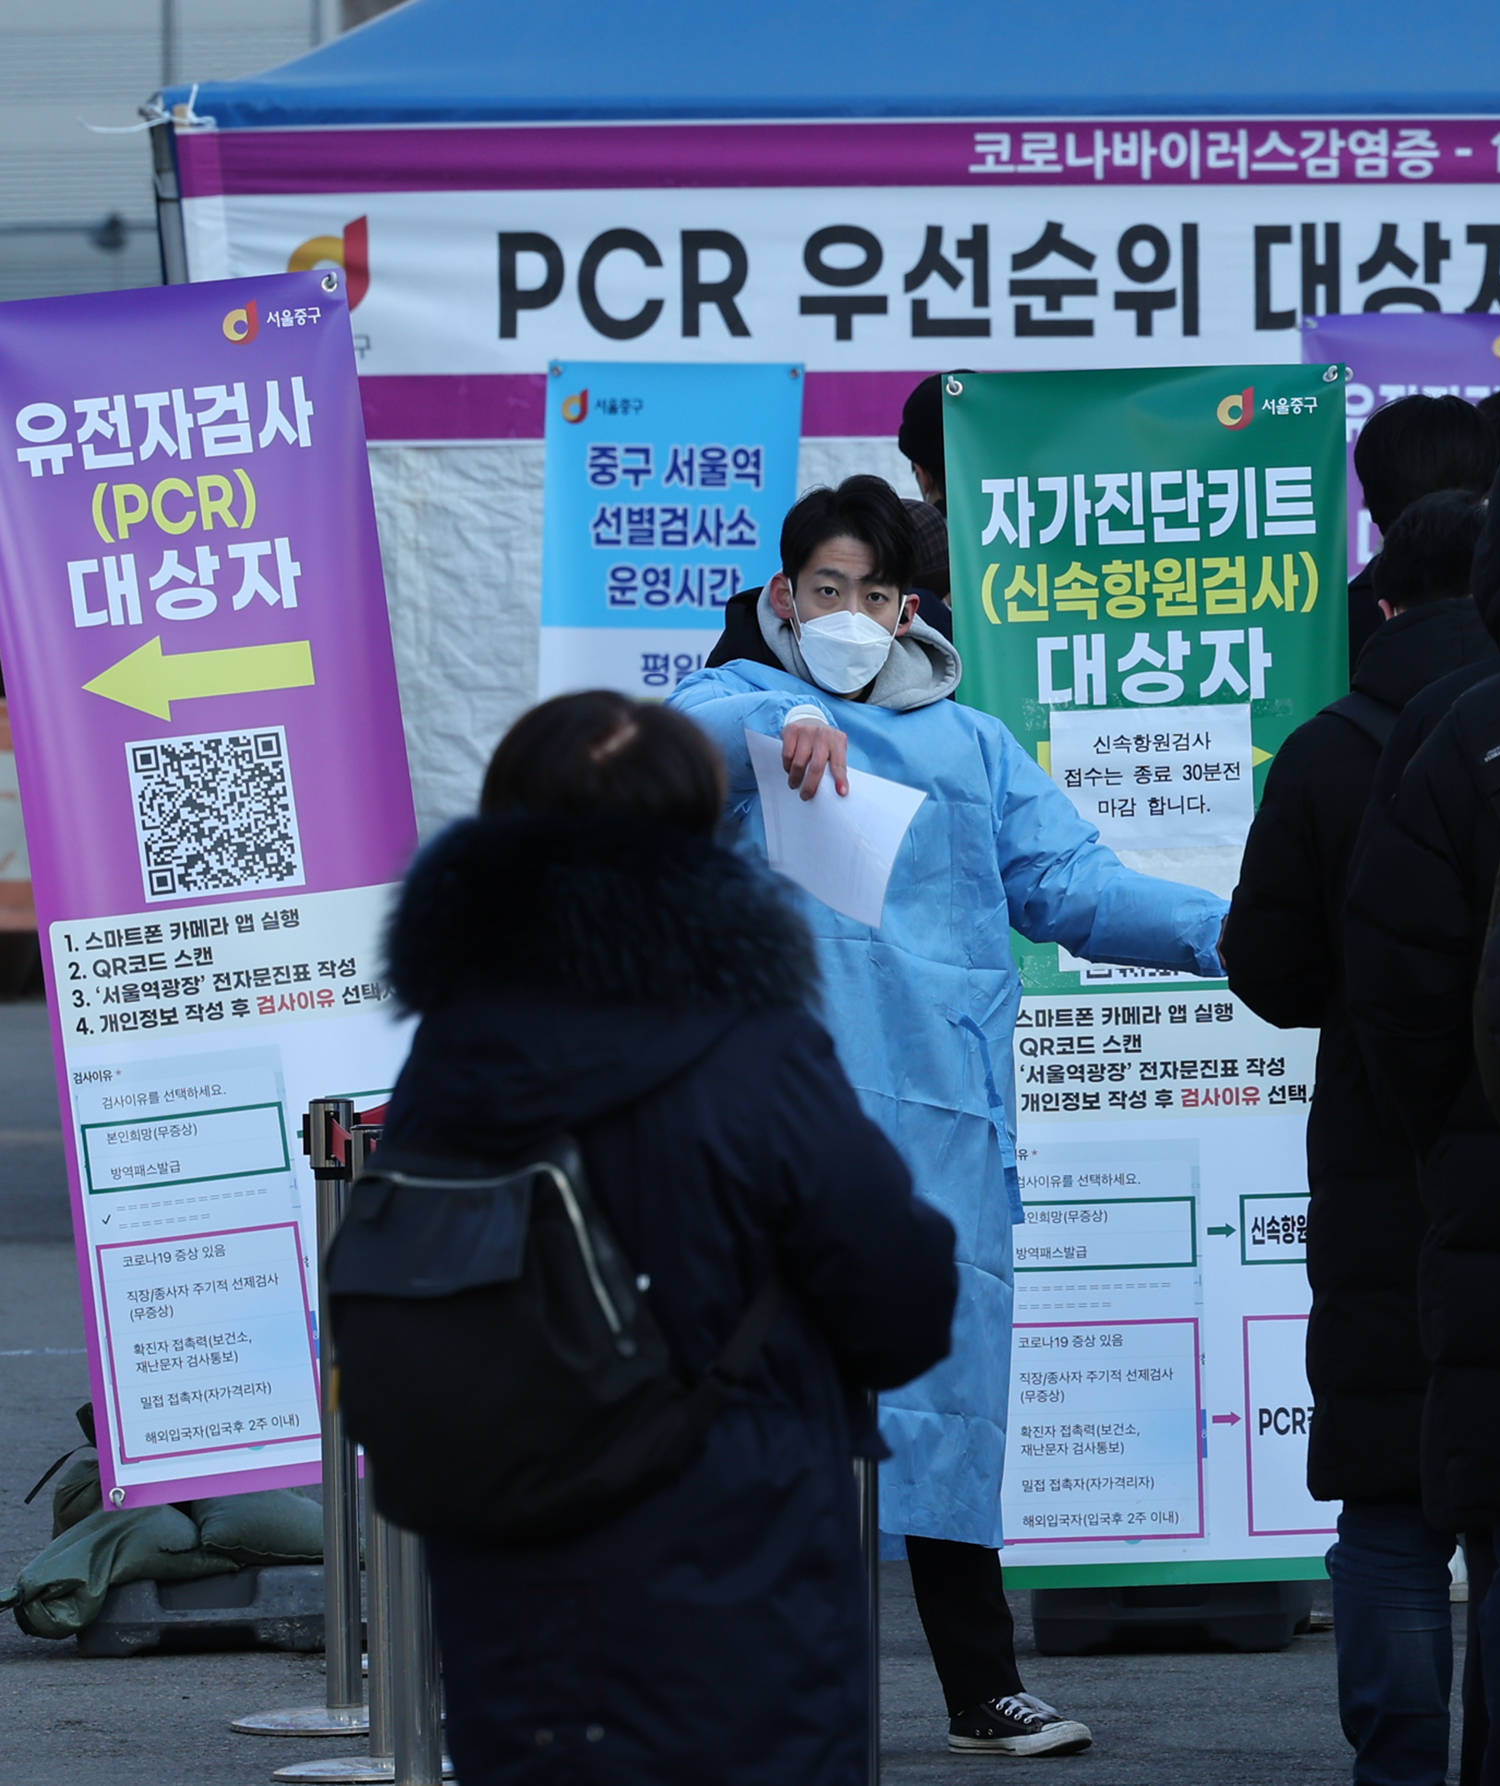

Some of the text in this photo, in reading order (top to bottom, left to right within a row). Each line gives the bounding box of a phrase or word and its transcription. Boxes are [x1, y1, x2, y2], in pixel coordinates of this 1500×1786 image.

[969, 129, 1441, 180] 코로나바이러스감염증
[497, 227, 752, 340] PCR
[798, 220, 1200, 341] 우선순위
[266, 307, 322, 328] 서울중구
[1261, 396, 1319, 416] 서울중구
[15, 376, 315, 477] 유전자검사
[588, 446, 763, 488] 중구 서울역
[91, 468, 257, 543] (PCR)
[981, 466, 1317, 549] 자가진단키트
[592, 506, 757, 547] 선별검사소
[66, 537, 302, 628] 대상자
[608, 565, 741, 607] 운영시간
[981, 551, 1319, 625] (신속항원검사)
[1036, 627, 1273, 706] 대상자
[1092, 731, 1212, 755] 신속항원검사
[1064, 761, 1242, 788] 접수는 종료 30분전
[1098, 794, 1211, 818] 마감 합니다.
[64, 908, 300, 953] 1. 스마트폰 카메라 앱 실행
[67, 947, 214, 981] 2. QR코드 스캔
[72, 990, 91, 1008] 3.
[212, 963, 312, 993] 전자문진표
[318, 957, 357, 980] 작성
[75, 1017, 95, 1036] 4.
[100, 1007, 179, 1034] 개인정보
[185, 1001, 224, 1023] 작성
[231, 998, 251, 1018] 후
[257, 988, 336, 1015] 검사이유
[1015, 1003, 1234, 1029] 스마트폰 카메라 앱 실행
[1019, 1034, 1142, 1058] QR코드 스캔
[73, 1069, 113, 1085] 검사이유
[1139, 1058, 1239, 1082] 전자문진표
[1246, 1057, 1286, 1077] 작성
[101, 1084, 227, 1110] 검사이유를 선택하세요.
[1021, 1084, 1313, 1112] 개인정보 작성 후 검사이유 선택
[106, 1122, 198, 1145] 본인희망(무증상)
[110, 1160, 181, 1181] 방역패스발급
[1079, 1172, 1141, 1187] 선택하세요.
[1023, 1210, 1108, 1225] 인희망(무증상)
[122, 1243, 226, 1268] 코로나19 증상 있음
[1016, 1246, 1087, 1260] 방역패스발급
[126, 1272, 279, 1304] 직장/종사자 주기적 선제검사
[129, 1304, 174, 1322] (무증상)
[133, 1339, 169, 1357] 확진자
[1018, 1333, 1123, 1350] 코로나19 증상 있음
[135, 1350, 239, 1374] 재난문자 검사통보)
[1019, 1368, 1173, 1387] 직장/종사자 주기적 선제검사
[140, 1381, 272, 1411] 밀접 접촉자(자가격리자)
[1020, 1388, 1065, 1404] (무증상)
[144, 1413, 300, 1443] 해외입국자(입국후 2주 이내)
[1020, 1424, 1056, 1439] 확진자
[1021, 1441, 1125, 1457] 재난문자 검사통보)
[1022, 1476, 1155, 1493] 밀접 접촉자(자가격리자)
[1022, 1510, 1179, 1528] 해외입국자(입국후 2주 이내)
